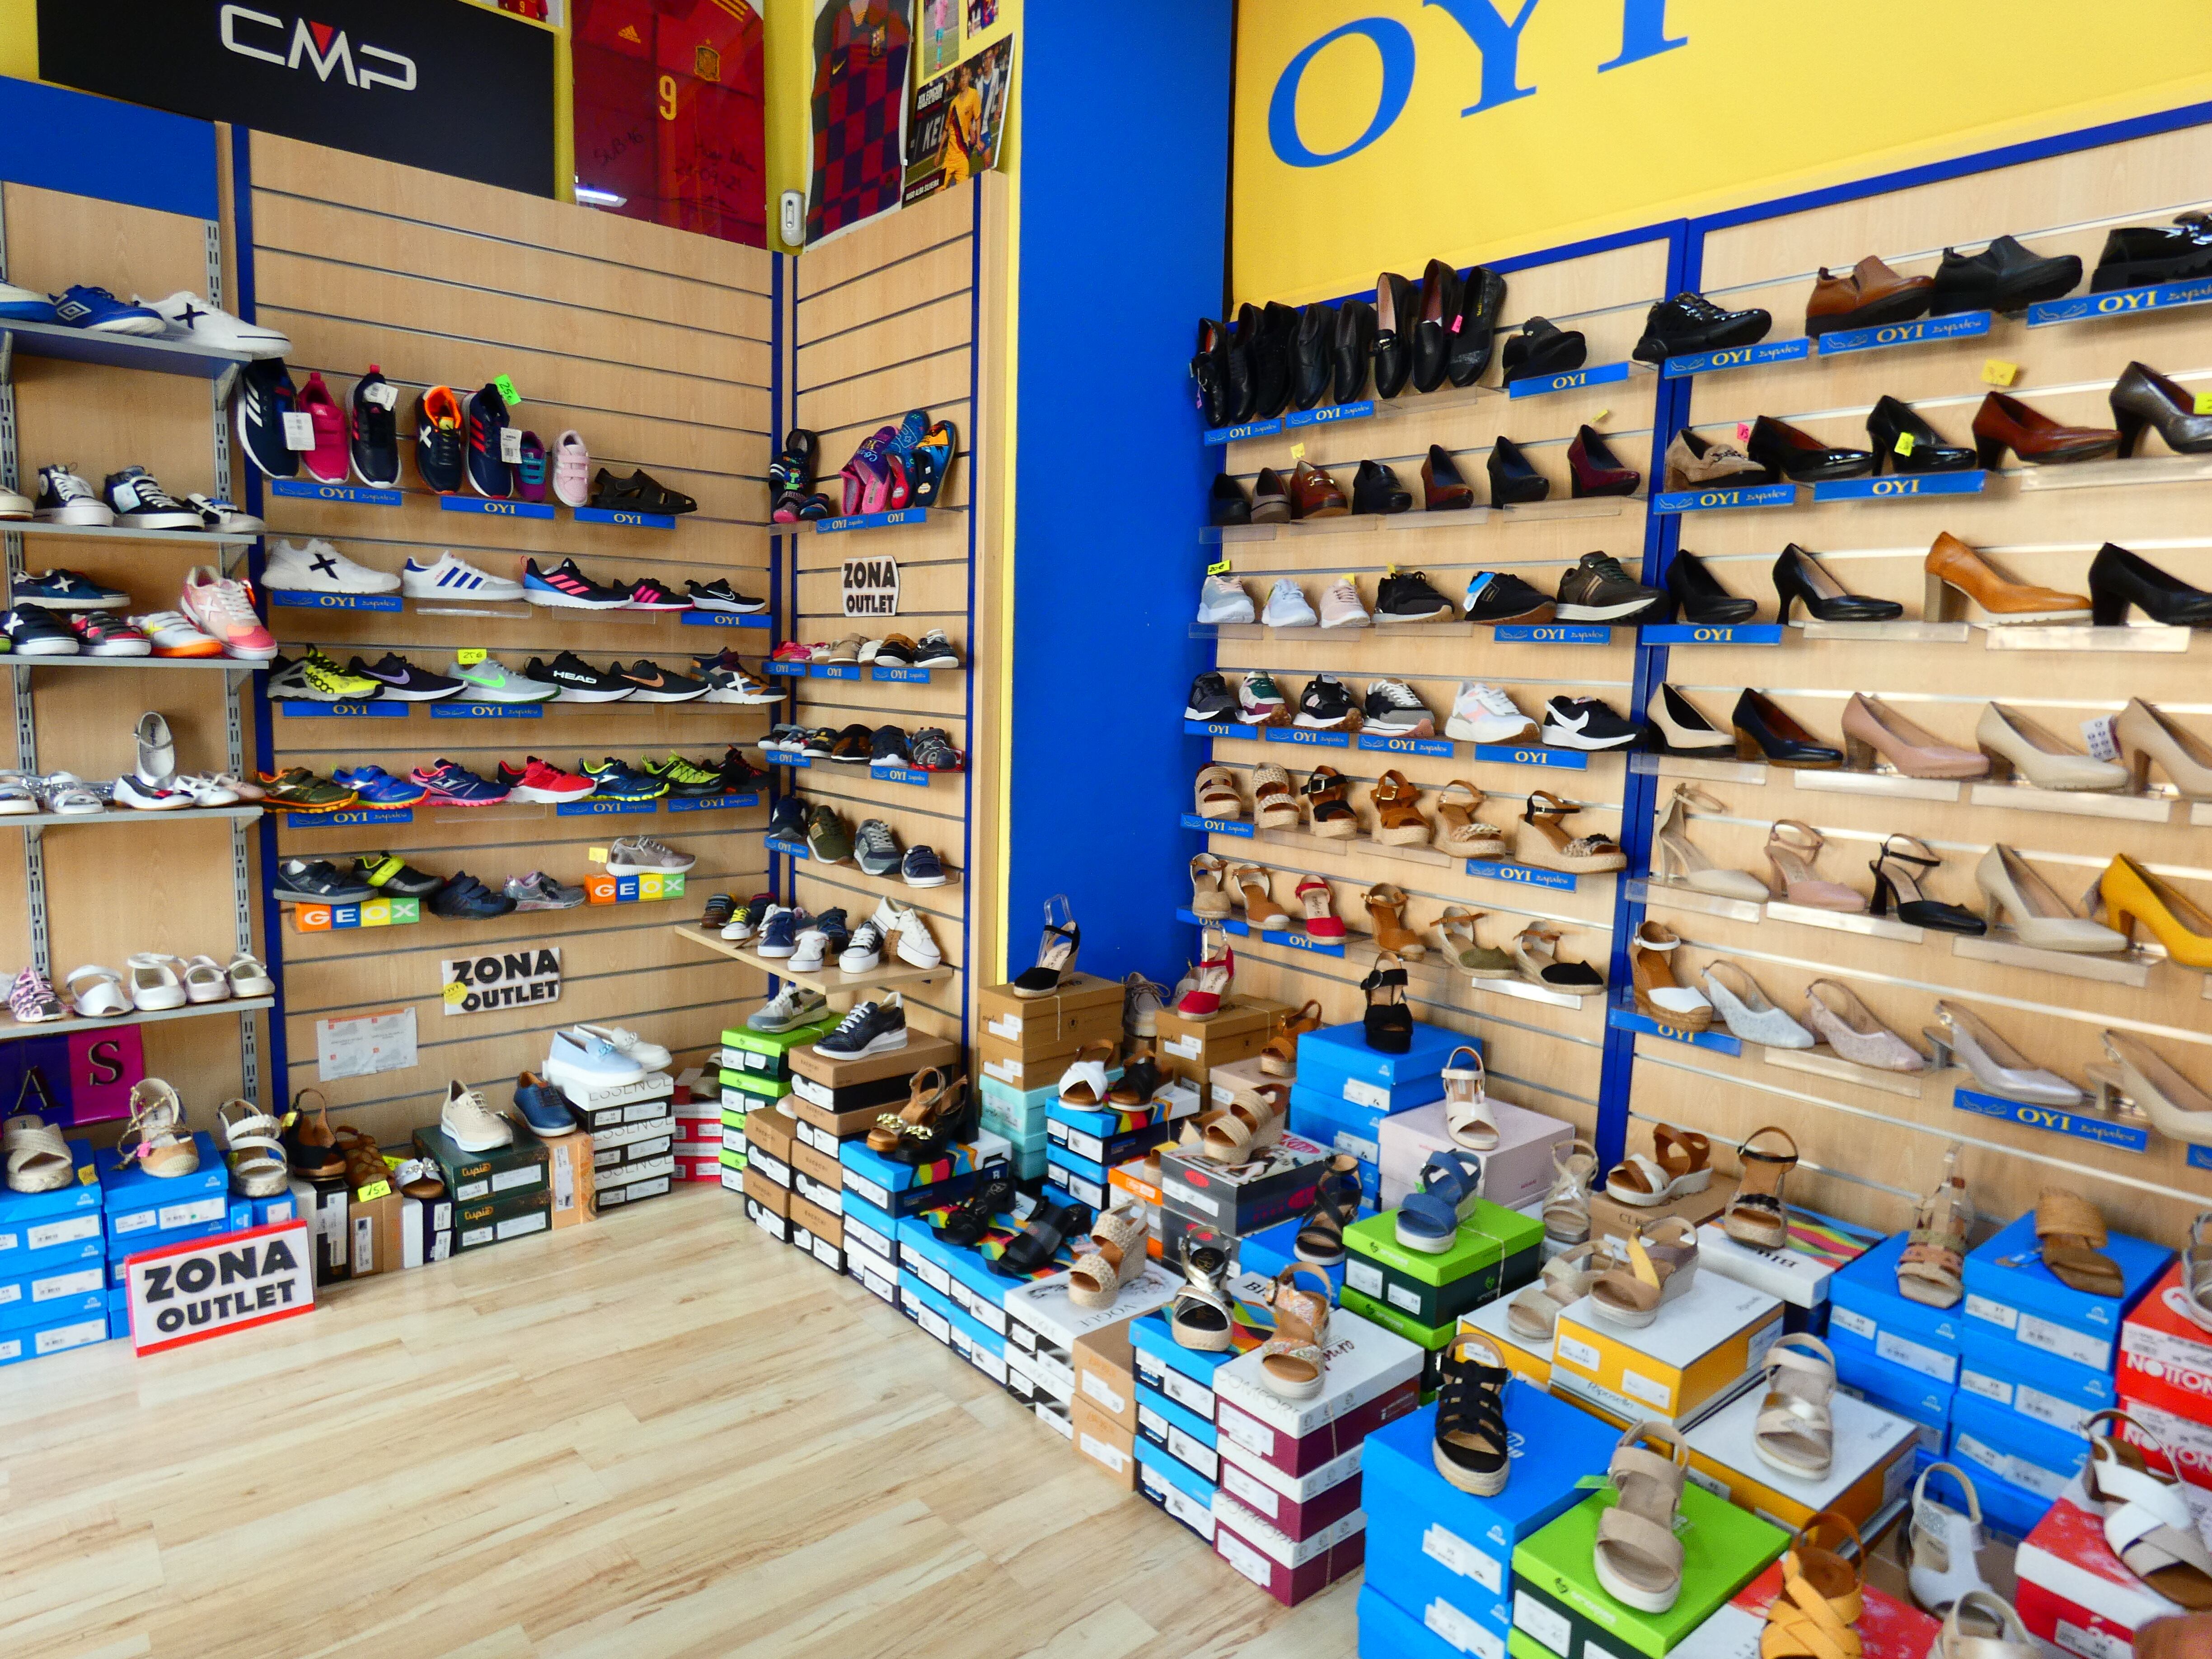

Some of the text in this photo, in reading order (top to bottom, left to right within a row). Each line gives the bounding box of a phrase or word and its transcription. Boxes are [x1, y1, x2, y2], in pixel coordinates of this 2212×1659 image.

[220, 4, 417, 90] CMP
[659, 75, 677, 120] 9
[2099, 291, 2157, 313] OYI
[1877, 322, 1923, 342] OYI
[1712, 347, 1751, 366] OYI
[1553, 370, 1585, 389] OYI
[1316, 408, 1340, 420] OYI
[1230, 426, 1251, 437] OYI
[1870, 476, 1919, 495] OYI
[320, 487, 354, 499] OYI
[1701, 488, 1739, 506] OYI
[484, 503, 515, 514] OYI
[614, 514, 641, 524] OYI
[888, 513, 904, 522] OYI
[832, 520, 847, 529] OYI
[844, 561, 896, 588] ZONA
[320, 596, 355, 606] OYI
[846, 595, 894, 614] OUTLET
[715, 616, 739, 624] OYI
[1533, 629, 1565, 639] OYI
[1694, 629, 1732, 641] OYI
[775, 664, 789, 673] OYI
[828, 668, 841, 676] OYI
[891, 668, 907, 679] OYI
[553, 670, 597, 684] HEAD
[333, 705, 367, 714] OYI
[472, 707, 502, 715] OYI
[1209, 725, 1229, 734] OYI
[1293, 732, 1316, 742] OYI
[1388, 740, 1415, 750] OYI
[1514, 751, 1547, 764] OYI
[890, 771, 906, 780] OYI
[594, 803, 620, 811] OYI
[700, 799, 724, 807] OYI
[334, 812, 367, 822] OYI
[1205, 820, 1224, 830] OYI
[778, 843, 790, 851] OYI
[1500, 868, 1530, 881] OYI
[595, 879, 683, 898] GEOX
[304, 903, 416, 925] GEOX
[452, 949, 559, 986] ZONA
[461, 980, 559, 1012] OUTLET
[2017, 1108, 2070, 1130] OYI
[145, 1240, 299, 1303] ZONA
[156, 1279, 295, 1332] OUTLET
